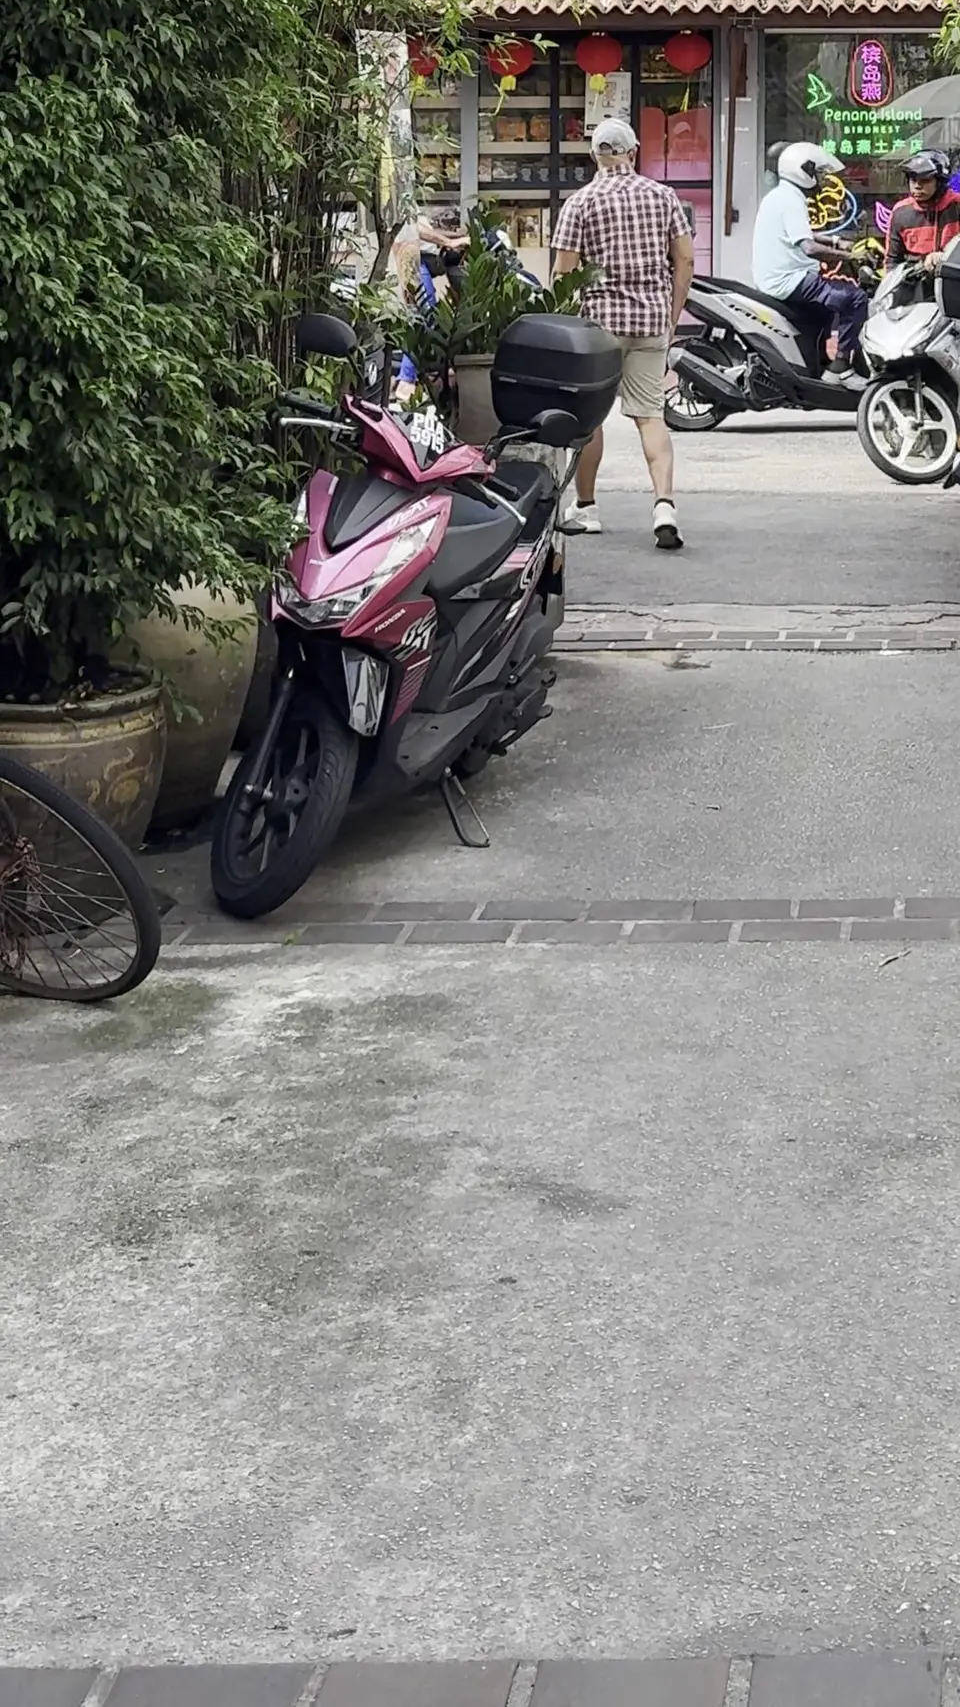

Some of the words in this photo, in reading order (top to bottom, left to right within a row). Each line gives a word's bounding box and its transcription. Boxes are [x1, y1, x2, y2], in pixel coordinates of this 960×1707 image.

[824, 108, 878, 123] Penang
[880, 107, 922, 121] Island
[843, 125, 901, 135] BIRDNEST
[409, 426, 445, 455] 5915
[374, 608, 407, 634] HONDA
